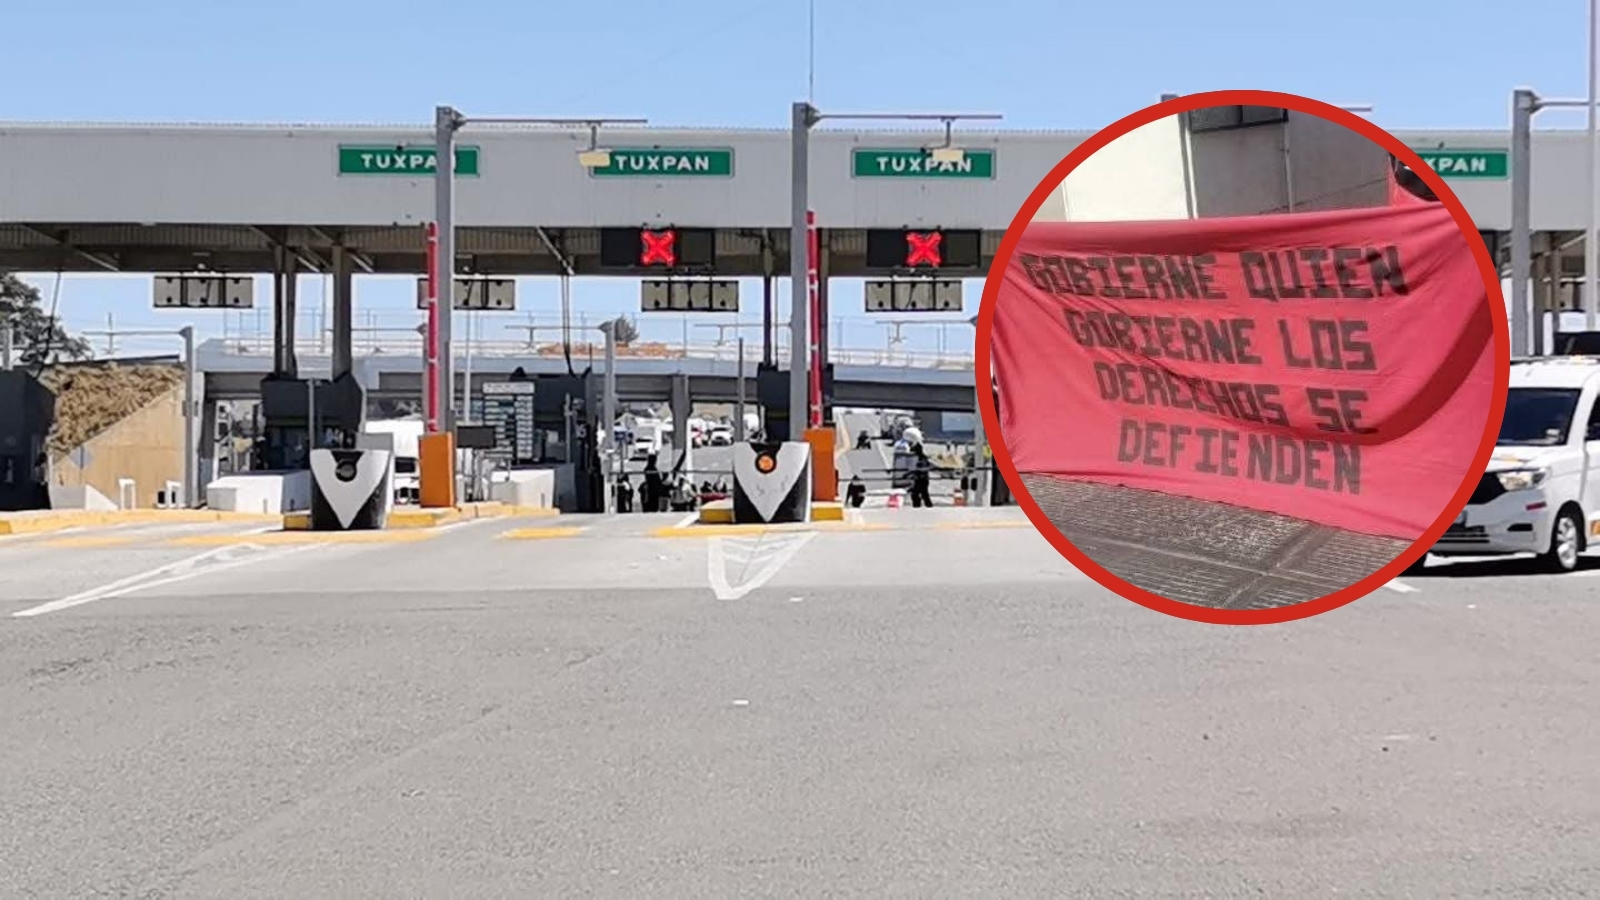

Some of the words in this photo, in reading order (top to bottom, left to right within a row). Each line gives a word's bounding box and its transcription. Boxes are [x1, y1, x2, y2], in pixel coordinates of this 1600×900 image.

[361, 154, 455, 169] TUXPA
[615, 155, 709, 170] TUXPAN
[1020, 254, 1227, 299] GOBIERNE
[1239, 246, 1408, 302] QUIEN
[1064, 309, 1262, 364] GOBIERNE
[1279, 319, 1377, 370] LOS
[1095, 361, 1290, 427] DERECHOS
[1306, 387, 1378, 434] SE
[1117, 419, 1361, 494] DEFIENDEN
